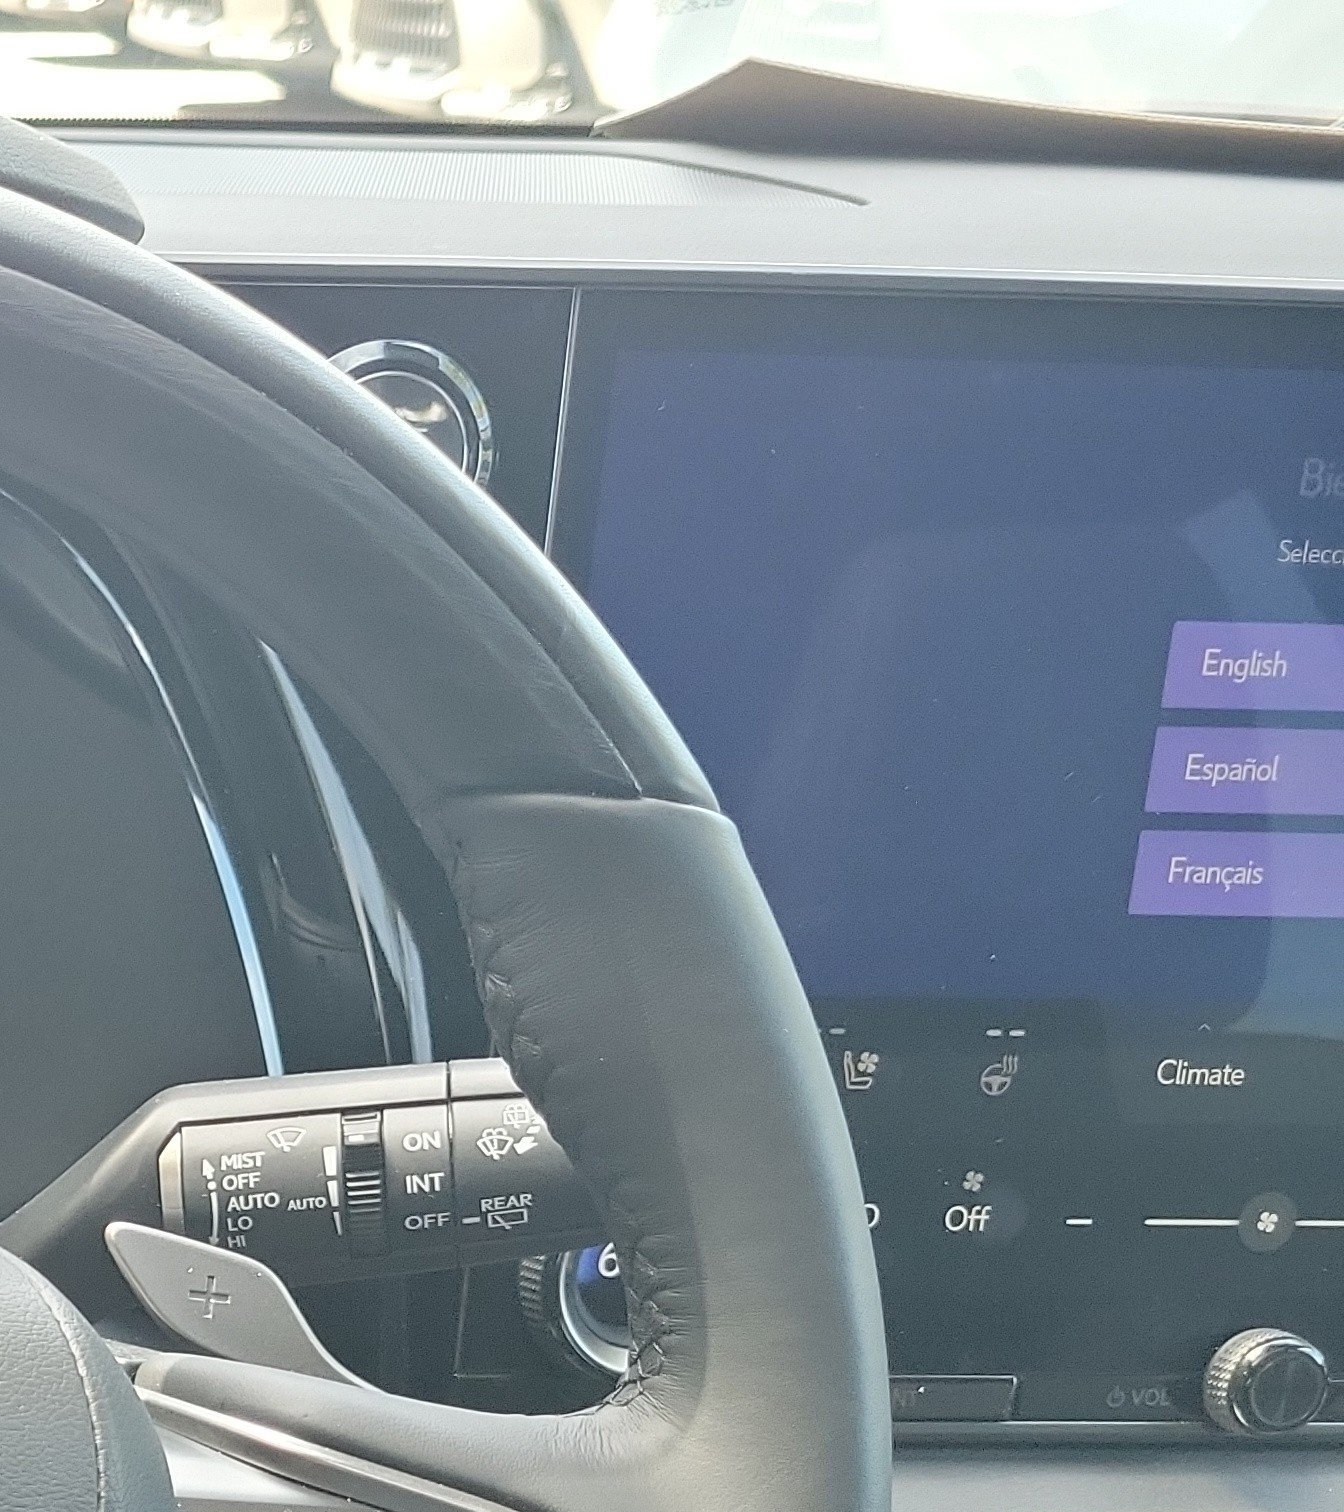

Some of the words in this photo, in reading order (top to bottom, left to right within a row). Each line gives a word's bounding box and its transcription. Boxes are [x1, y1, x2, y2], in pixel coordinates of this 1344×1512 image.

[1201, 647, 1288, 683] English
[1184, 754, 1280, 787] Español
[1168, 857, 1264, 892] Français
[1156, 1059, 1245, 1087] Climate
[402, 1131, 441, 1151] ON
[220, 1151, 265, 1170] MIST
[222, 1172, 260, 1190] OFF
[405, 1172, 445, 1194] INT
[227, 1192, 280, 1213] AUTO
[287, 1196, 327, 1212] AUTO
[480, 1193, 532, 1212] REAR
[227, 1216, 253, 1232] LO
[404, 1212, 451, 1230] OFF
[945, 1205, 992, 1232] Off
[228, 1235, 246, 1248] HI
[1131, 1388, 1171, 1407] VOL
